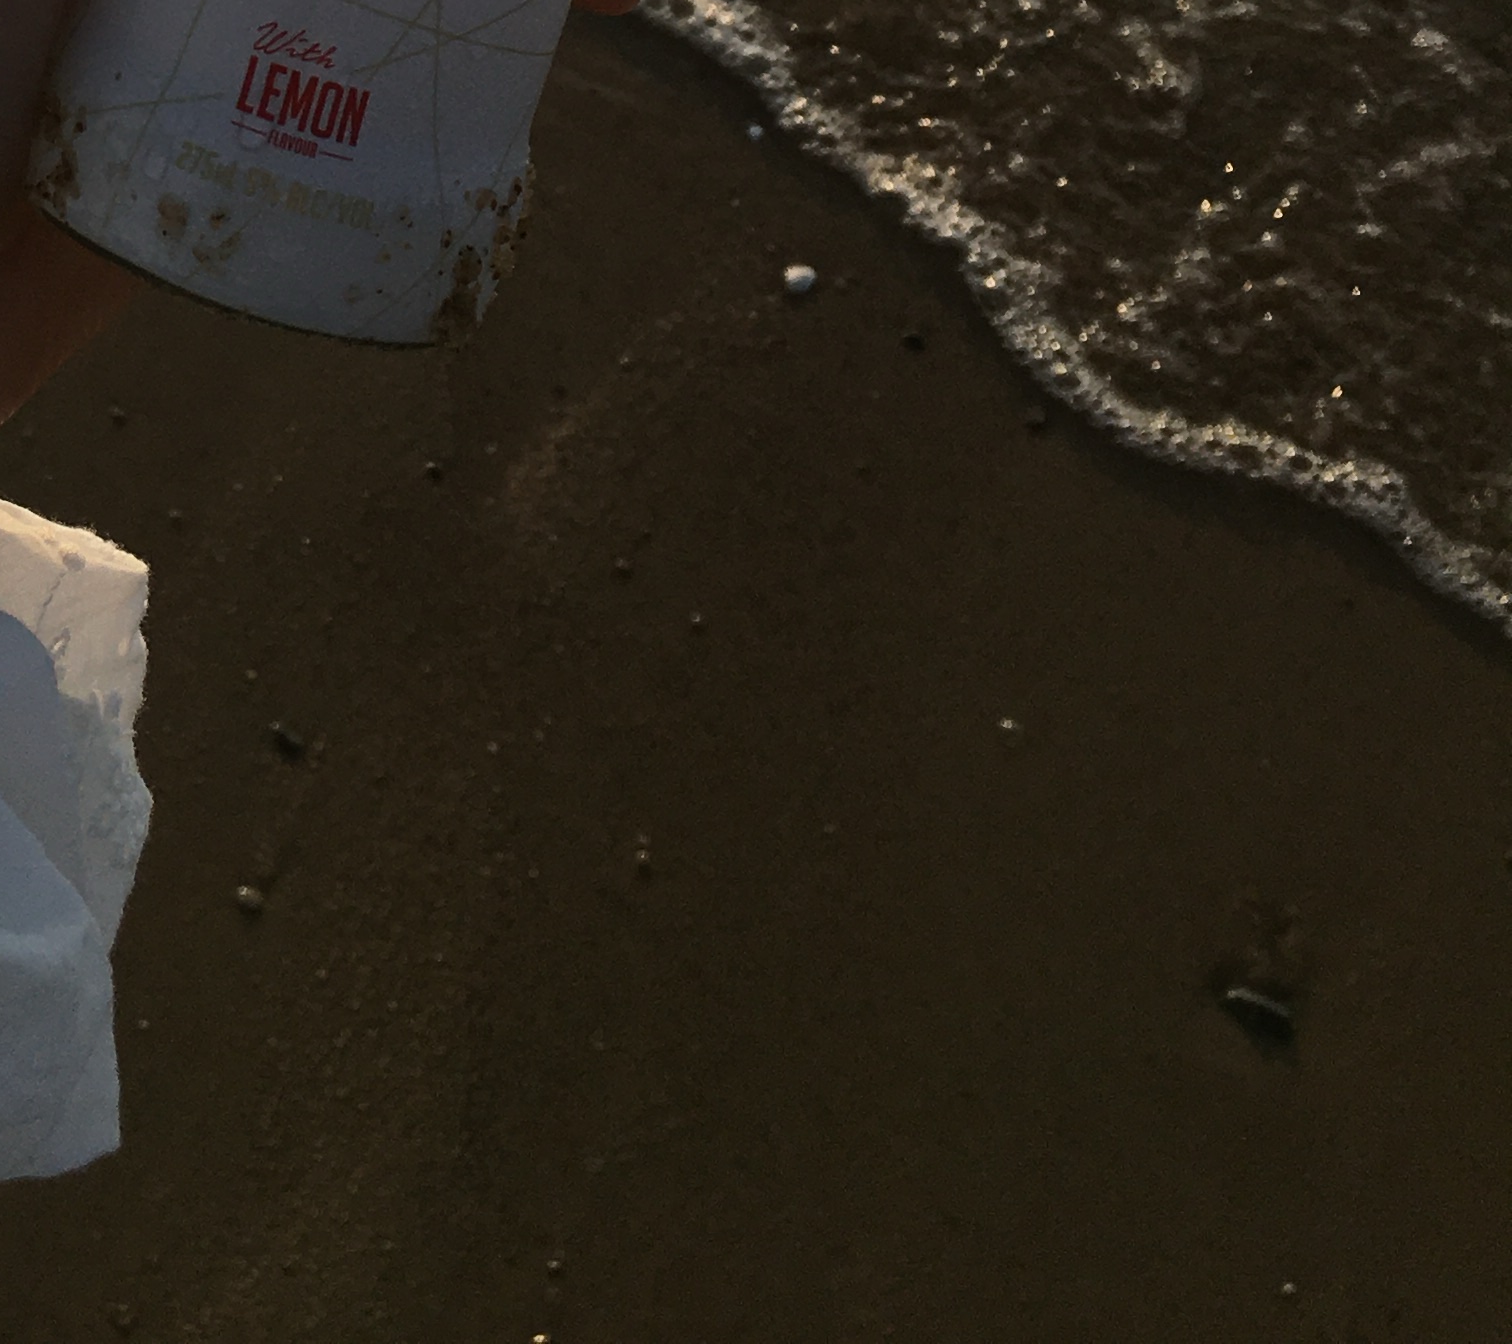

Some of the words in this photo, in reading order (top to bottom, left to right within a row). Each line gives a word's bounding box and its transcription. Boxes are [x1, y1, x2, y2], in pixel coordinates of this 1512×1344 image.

[253, 20, 337, 69] With
[236, 54, 371, 147] LEMON
[267, 128, 319, 159] FLAVOUR
